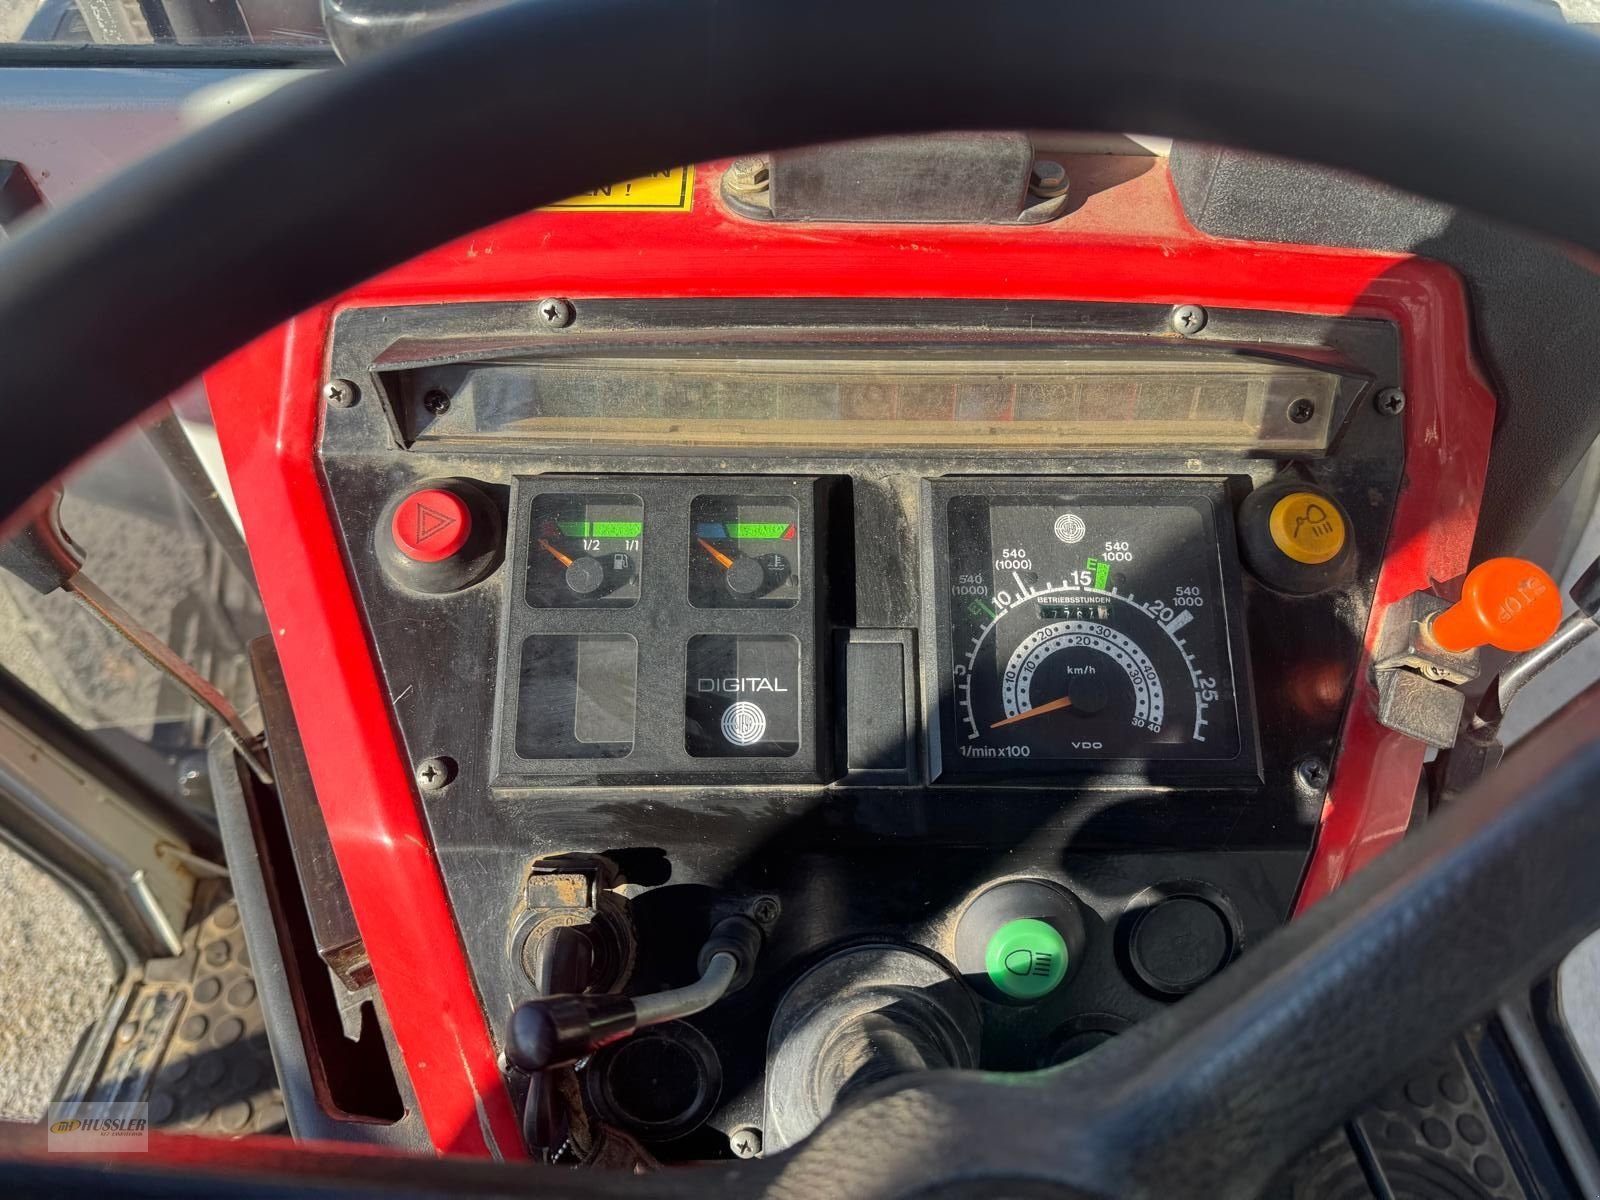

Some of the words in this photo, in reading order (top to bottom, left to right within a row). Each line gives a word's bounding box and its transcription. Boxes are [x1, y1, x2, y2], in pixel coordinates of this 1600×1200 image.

[583, 540, 600, 551] 1/2
[625, 540, 639, 551] 1/1
[1105, 541, 1129, 551] 540
[1002, 549, 1026, 558] 540
[1102, 552, 1133, 561] 1000
[995, 559, 1032, 570] (1000)
[1086, 557, 1098, 570] E
[959, 574, 983, 585] 540
[1070, 571, 1092, 586] 15
[951, 585, 988, 596] (1000)
[1175, 586, 1200, 596] 540
[991, 591, 1012, 609] 10
[1037, 596, 1111, 604] BETRIEBSSTUNDEN
[1172, 596, 1204, 606] 1000
[1148, 599, 1175, 623] 20
[1038, 627, 1054, 640] 20
[1095, 625, 1112, 638] 30
[1076, 636, 1091, 646] 20
[1024, 660, 1036, 675] 10
[1067, 665, 1096, 675] km/h
[1144, 665, 1157, 681] 40
[1006, 671, 1016, 684] 10
[1129, 669, 1142, 686] 30
[697, 677, 788, 692] DIGITAL
[1200, 677, 1219, 702] 25
[1131, 718, 1146, 729] 30
[1147, 722, 1161, 733] 40
